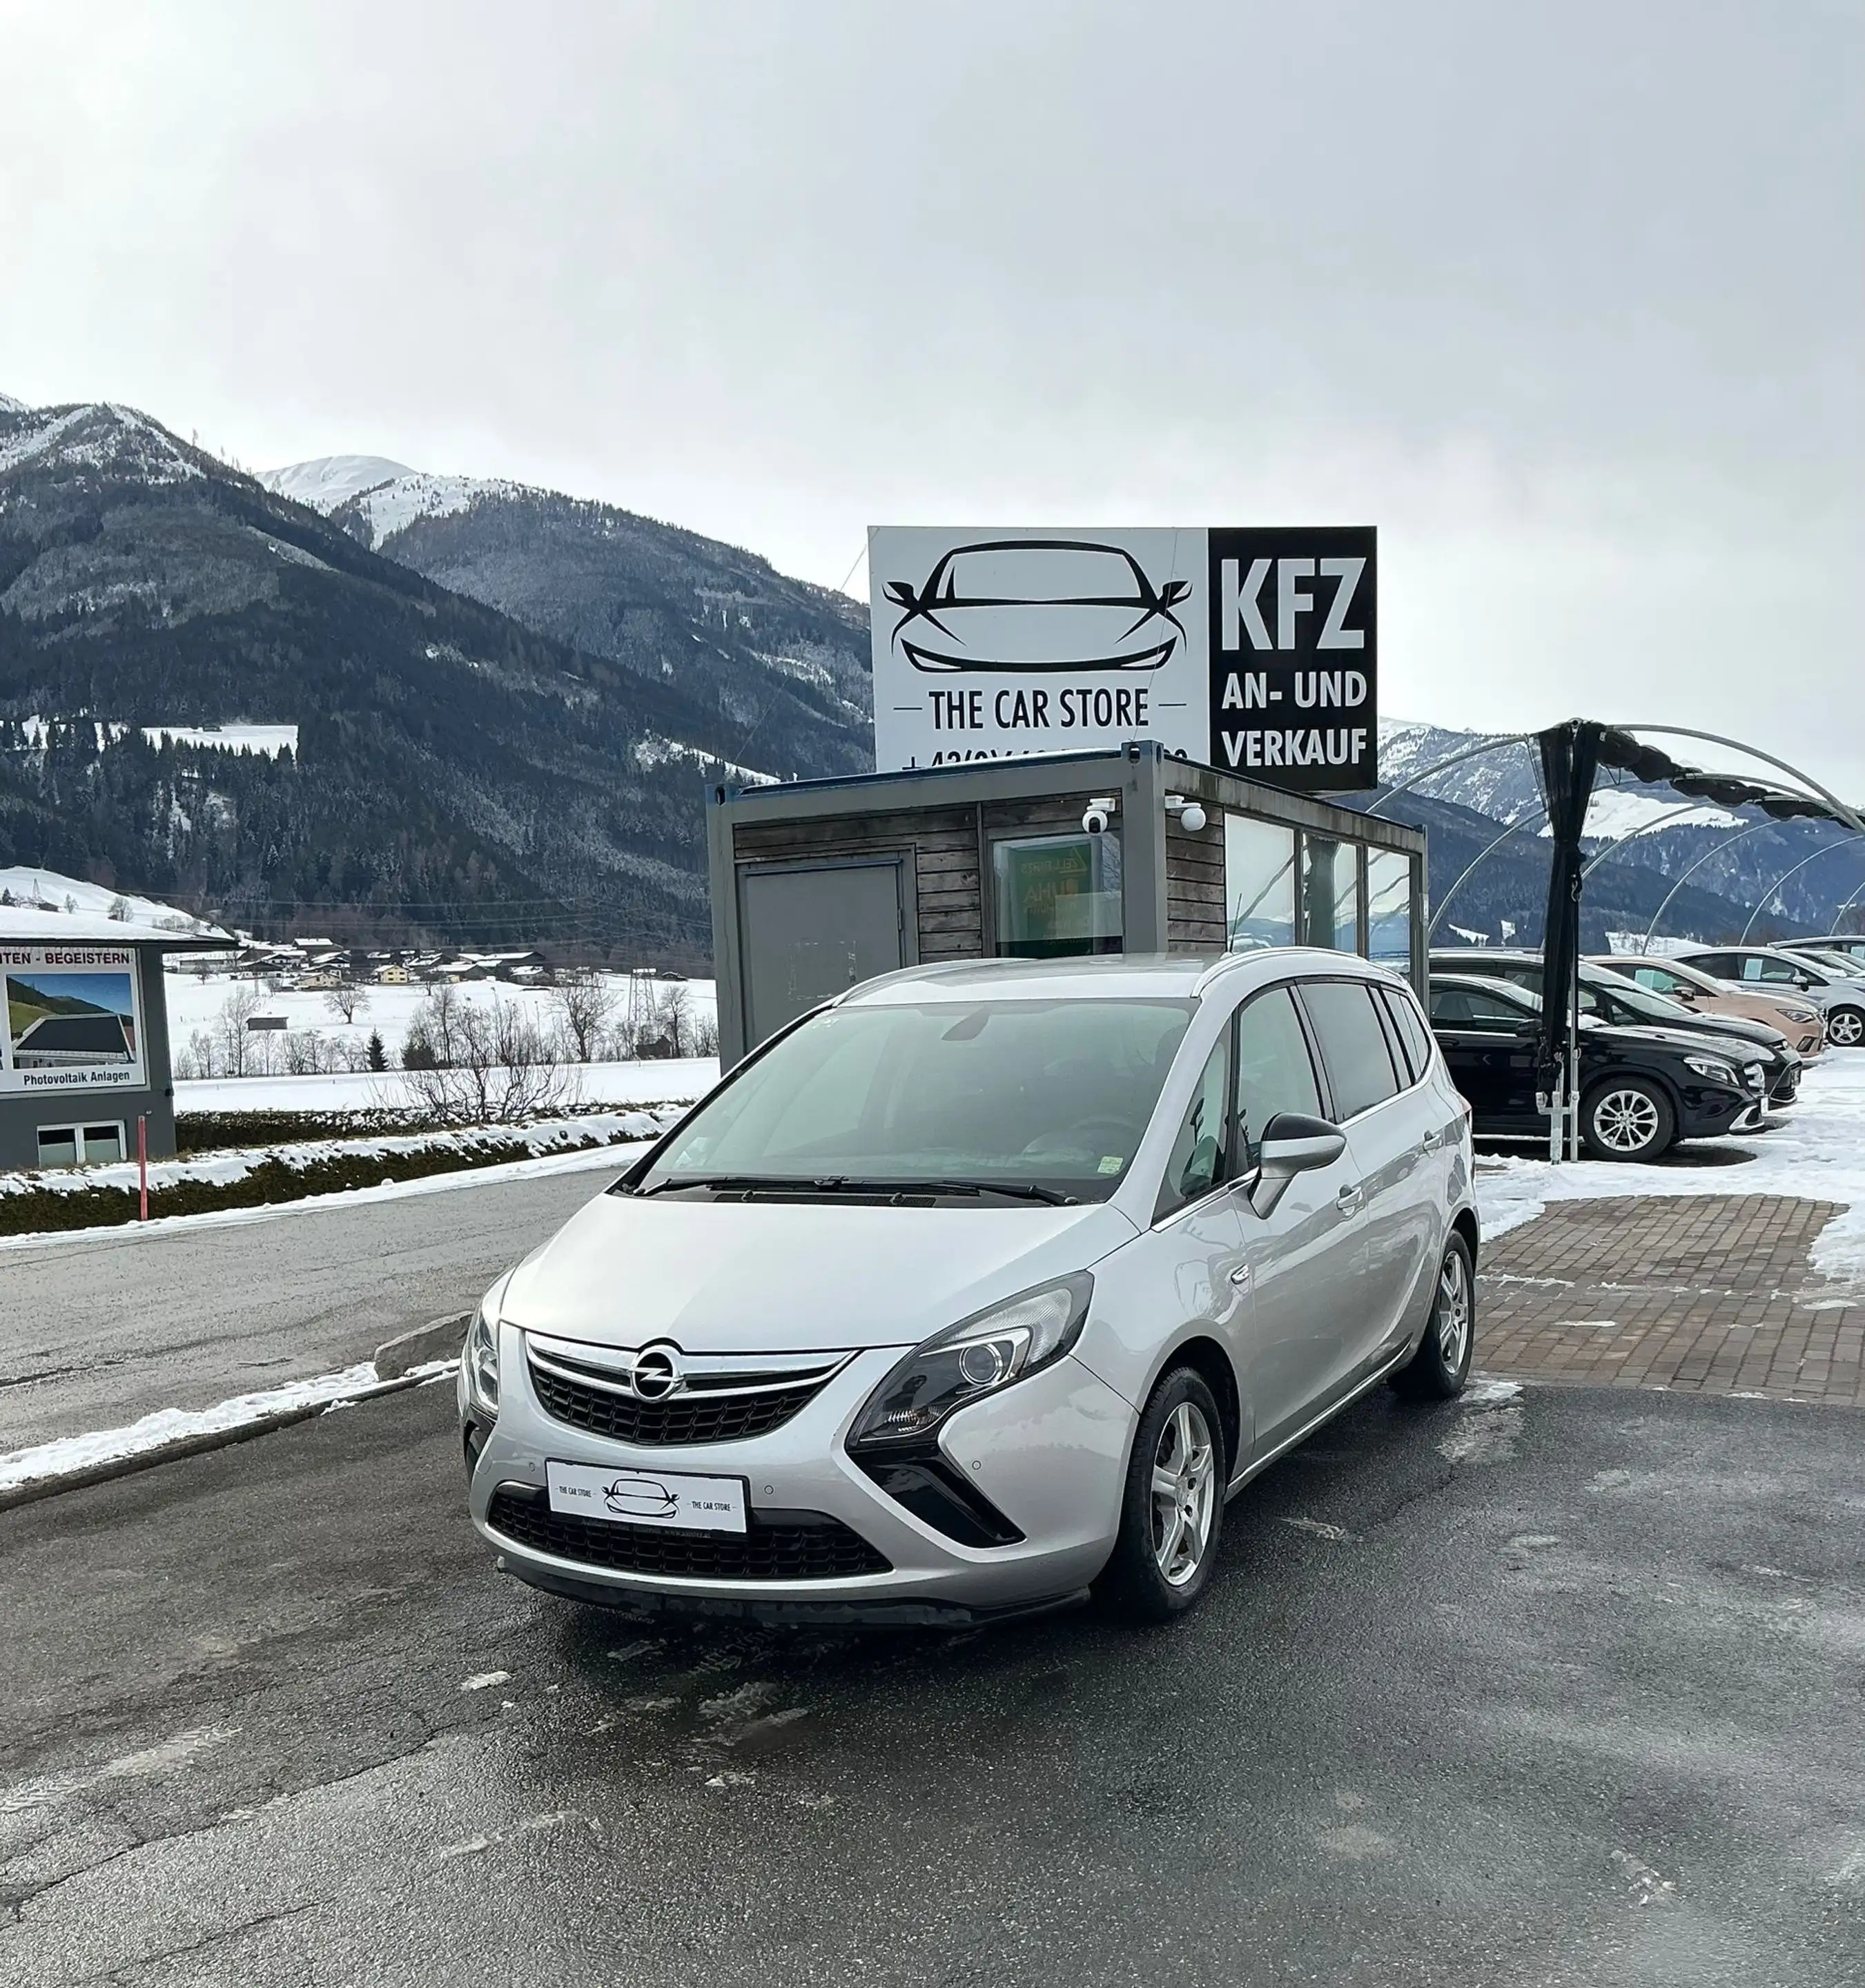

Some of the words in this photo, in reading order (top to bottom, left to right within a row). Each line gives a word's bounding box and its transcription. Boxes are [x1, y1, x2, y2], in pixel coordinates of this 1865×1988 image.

[1221, 557, 1367, 651] KFZ
[928, 690, 984, 729] THE
[995, 690, 1051, 728] CAR
[1060, 688, 1149, 728] STORE
[1221, 672, 1282, 709] AN-
[1294, 671, 1367, 708] UND
[1221, 729, 1367, 766] VERKAUF
[45, 952, 130, 964] BEGEISTERN
[23, 1072, 88, 1086] Photovoltaik
[90, 1071, 130, 1083] Anlagen
[691, 1501, 702, 1510] THE
[703, 1501, 713, 1510] CAR
[714, 1502, 732, 1512] STORE
